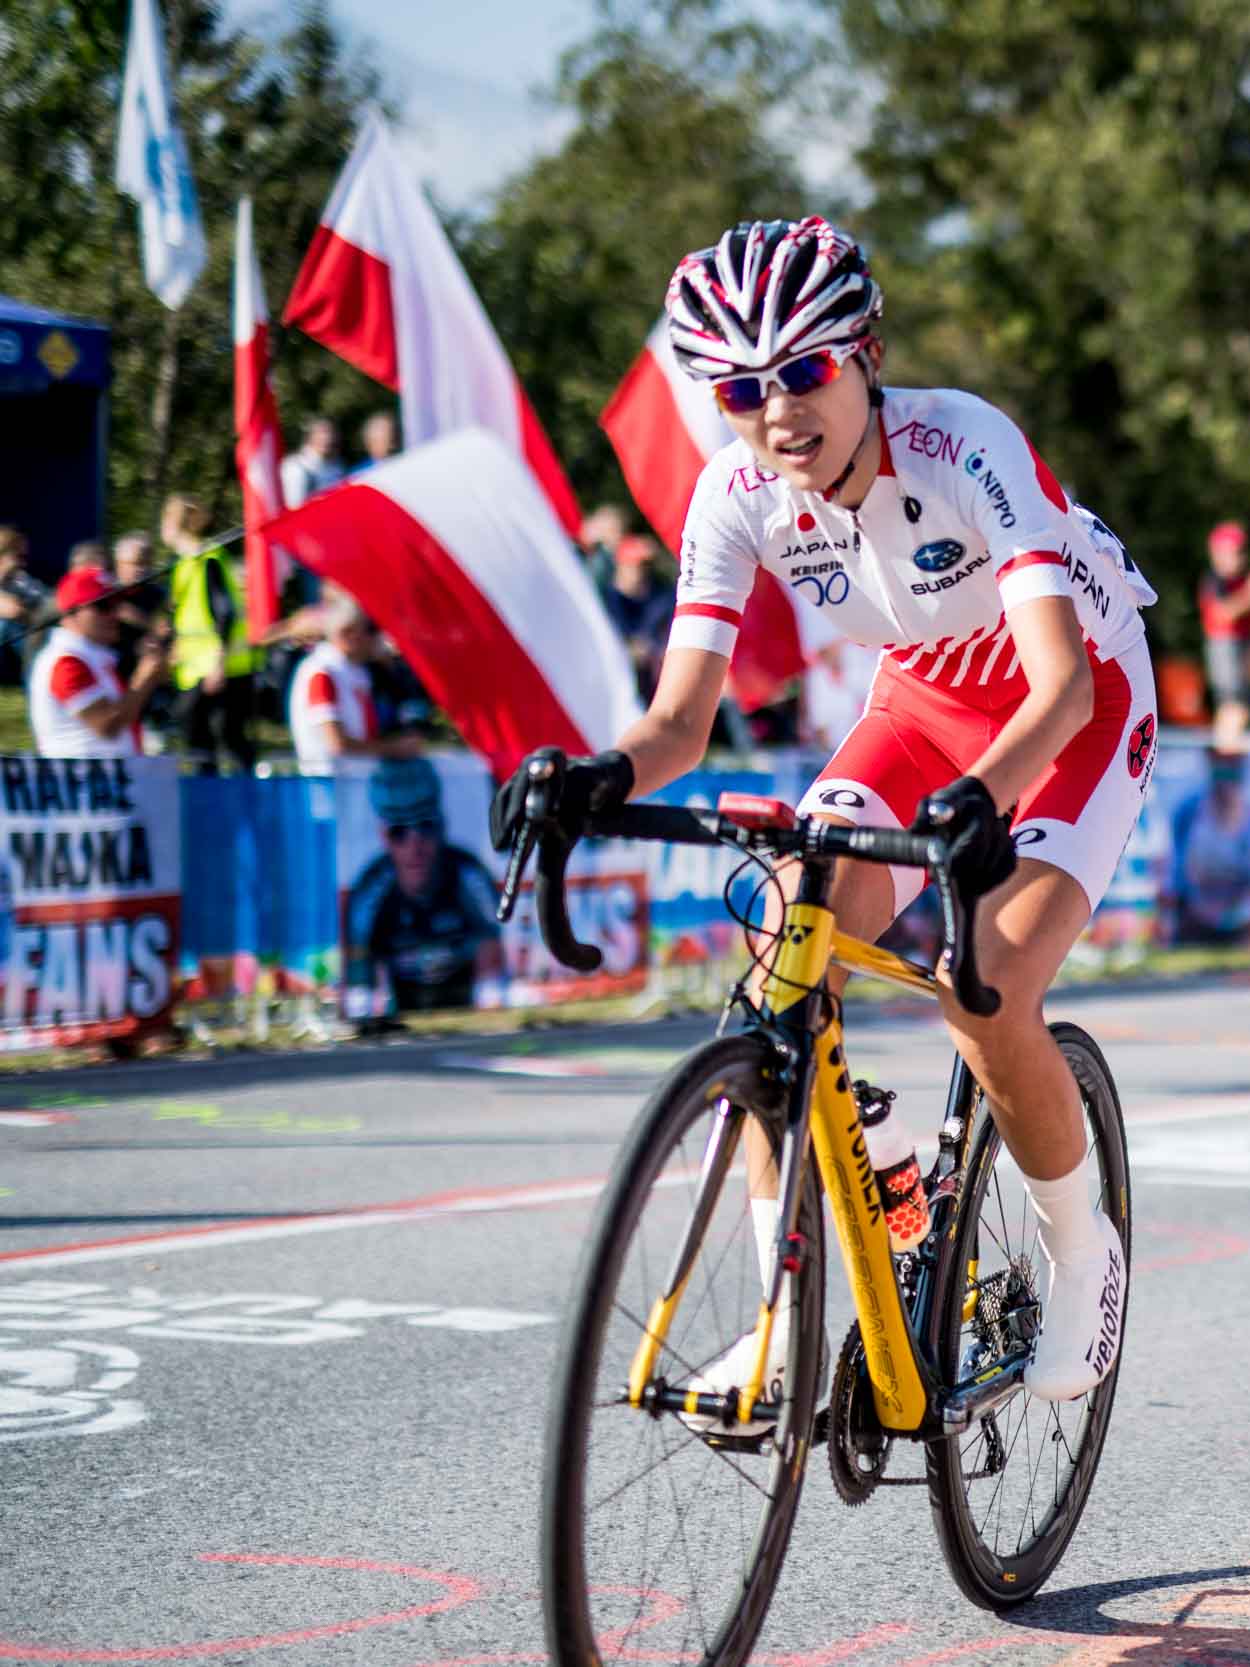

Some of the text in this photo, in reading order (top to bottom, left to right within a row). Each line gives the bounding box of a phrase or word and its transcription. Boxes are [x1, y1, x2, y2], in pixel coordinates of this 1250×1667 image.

[978, 469, 1016, 529] NIPPO
[780, 539, 848, 558] JAPAN
[911, 551, 993, 596] SUBARU
[2, 912, 171, 1025] FANS
